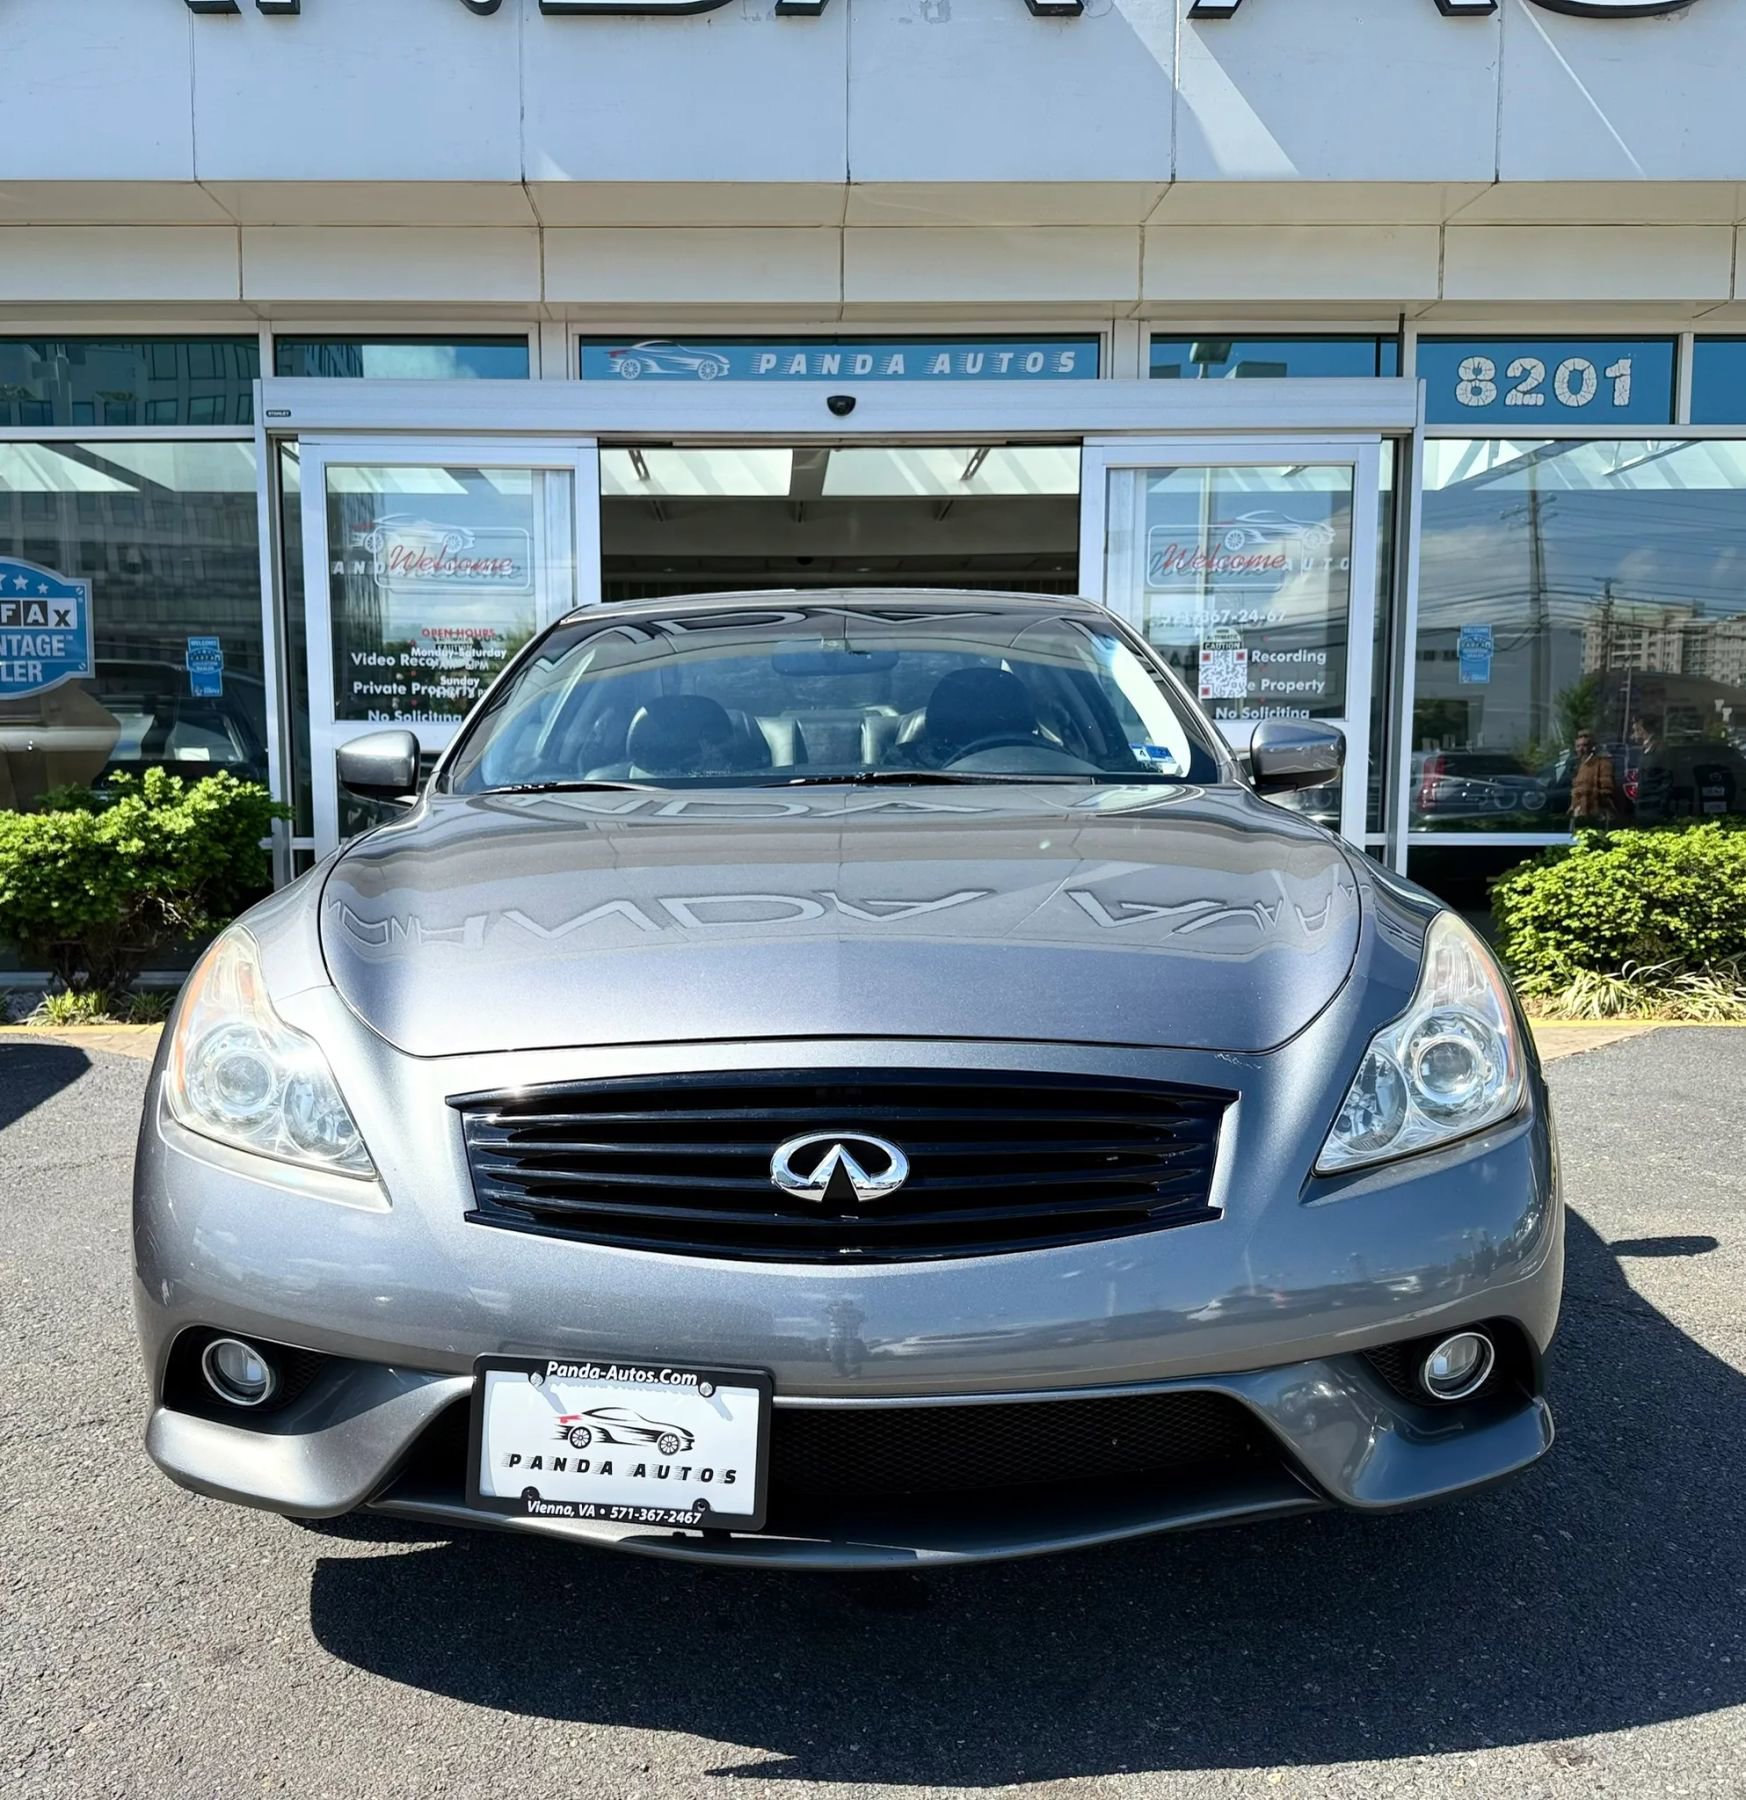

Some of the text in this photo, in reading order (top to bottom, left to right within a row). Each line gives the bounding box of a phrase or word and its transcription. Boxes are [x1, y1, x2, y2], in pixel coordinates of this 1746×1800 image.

[754, 351, 1075, 375] PANDA AUTOS
[1455, 357, 1632, 407] 8201
[391, 544, 513, 573] Welcome
[1163, 543, 1287, 570] Welcome
[351, 652, 396, 667] Video
[1251, 649, 1327, 665] Recording
[353, 681, 407, 695] Private
[440, 675, 480, 688] Sunday
[1261, 678, 1325, 694] Property
[368, 710, 389, 722] No
[1215, 707, 1237, 719] No
[546, 1361, 698, 1386] Panda-Autos.Com
[505, 1453, 737, 1484] PANDA AUTOS
[527, 1500, 702, 1525] Vienna, VA 571-367-2467
